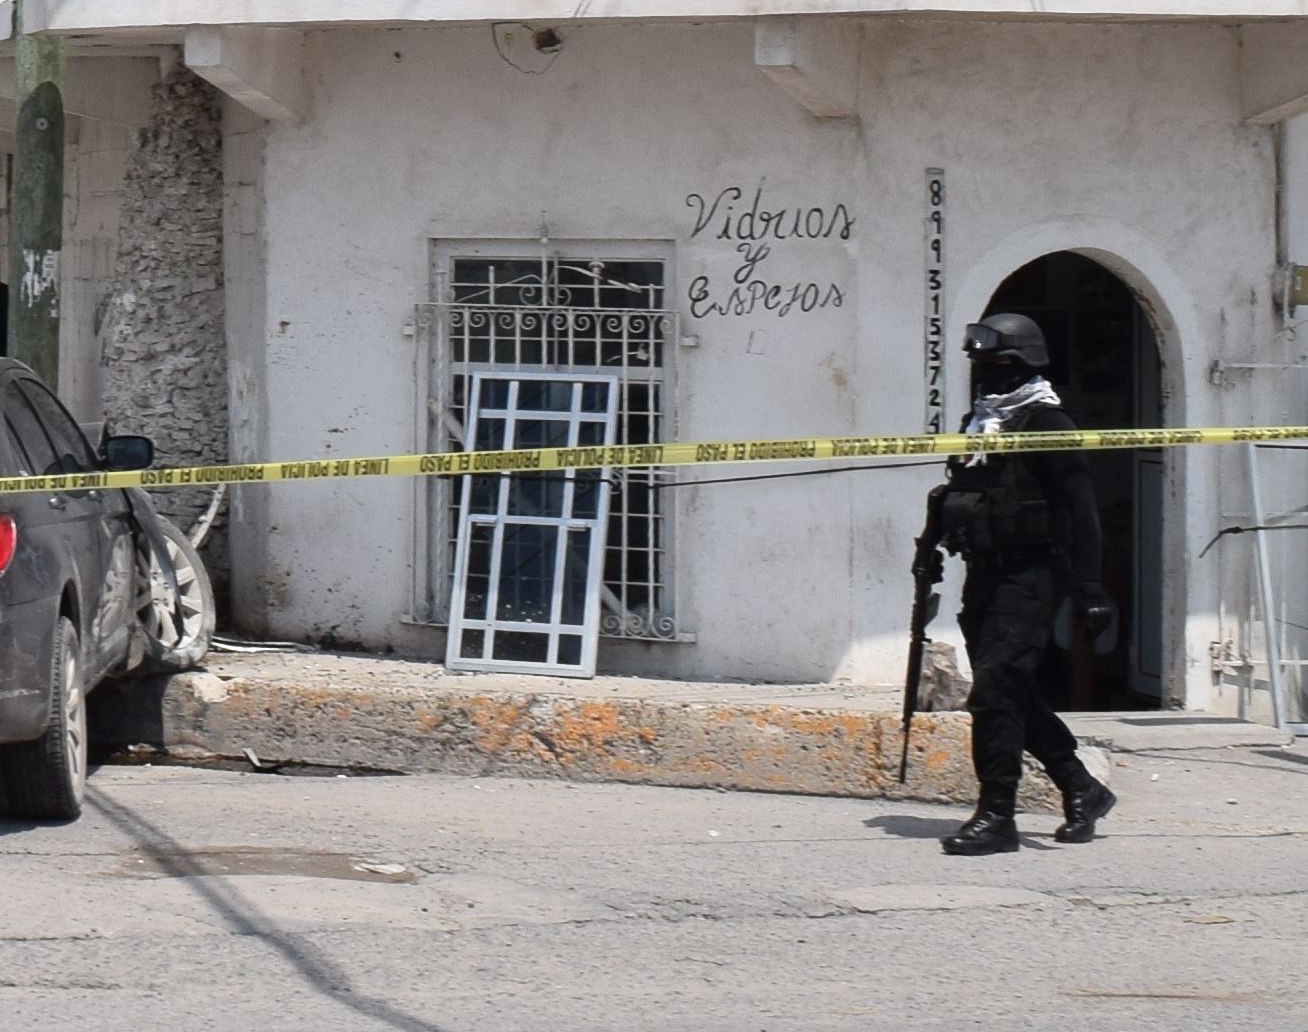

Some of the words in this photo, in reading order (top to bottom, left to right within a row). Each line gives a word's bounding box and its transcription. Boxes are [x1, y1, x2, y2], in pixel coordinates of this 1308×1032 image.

[557, 448, 604, 467] POLICIA
[608, 447, 625, 466] DE
[628, 445, 663, 465] LINEA
[695, 443, 728, 463] PASO
[733, 442, 746, 461] EL
[749, 440, 816, 460] PROHIBIDO
[354, 458, 389, 476] LINEA
[420, 455, 452, 473] PASO
[457, 454, 470, 471] EL
[474, 450, 541, 470] PROHIBIDO
[140, 471, 172, 484] PASO
[179, 470, 191, 483] EL
[196, 466, 263, 481] PROHIBIDO
[281, 463, 328, 479] POLICIA
[333, 461, 348, 478] DE
